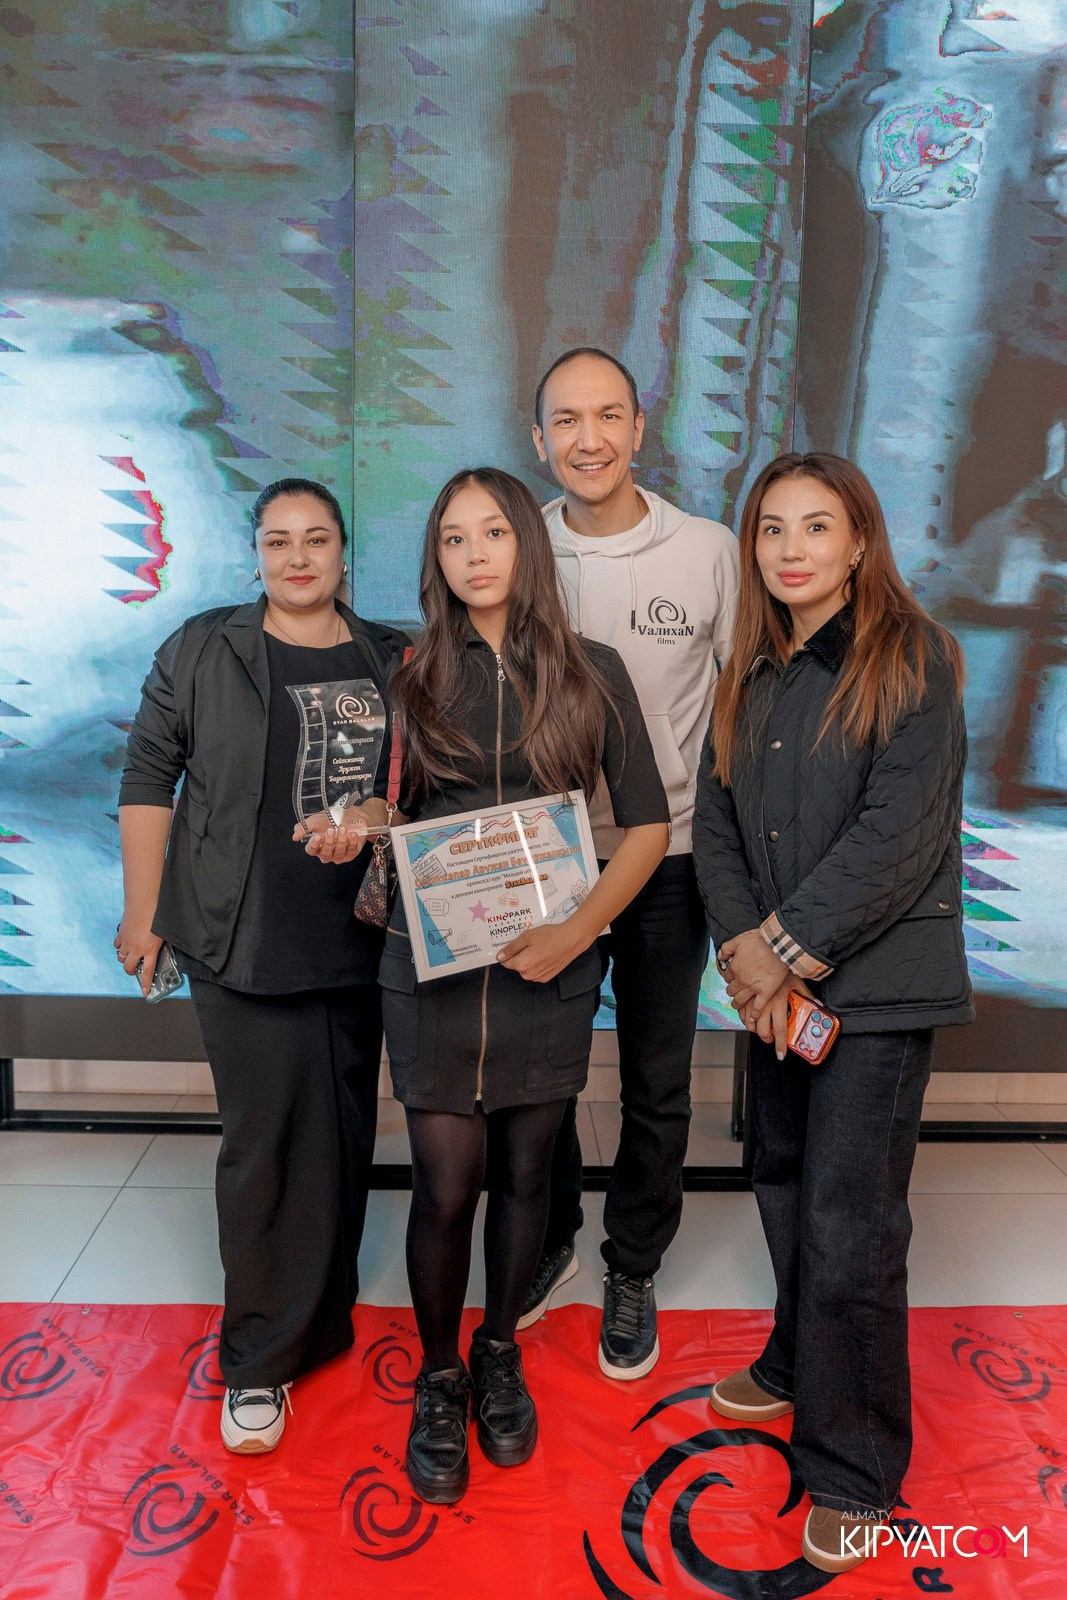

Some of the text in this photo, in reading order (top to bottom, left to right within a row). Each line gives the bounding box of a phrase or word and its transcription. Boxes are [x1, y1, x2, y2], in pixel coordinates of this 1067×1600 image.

[657, 637, 676, 645] films
[487, 907, 532, 923] KINOPARK
[489, 919, 533, 937] KINOPLEXX
[388, 1320, 420, 1338] ALAR
[169, 1444, 255, 1526] STAR BALALAR
[372, 1444, 475, 1524] STA ALAR
[4, 1493, 34, 1524] STAR
